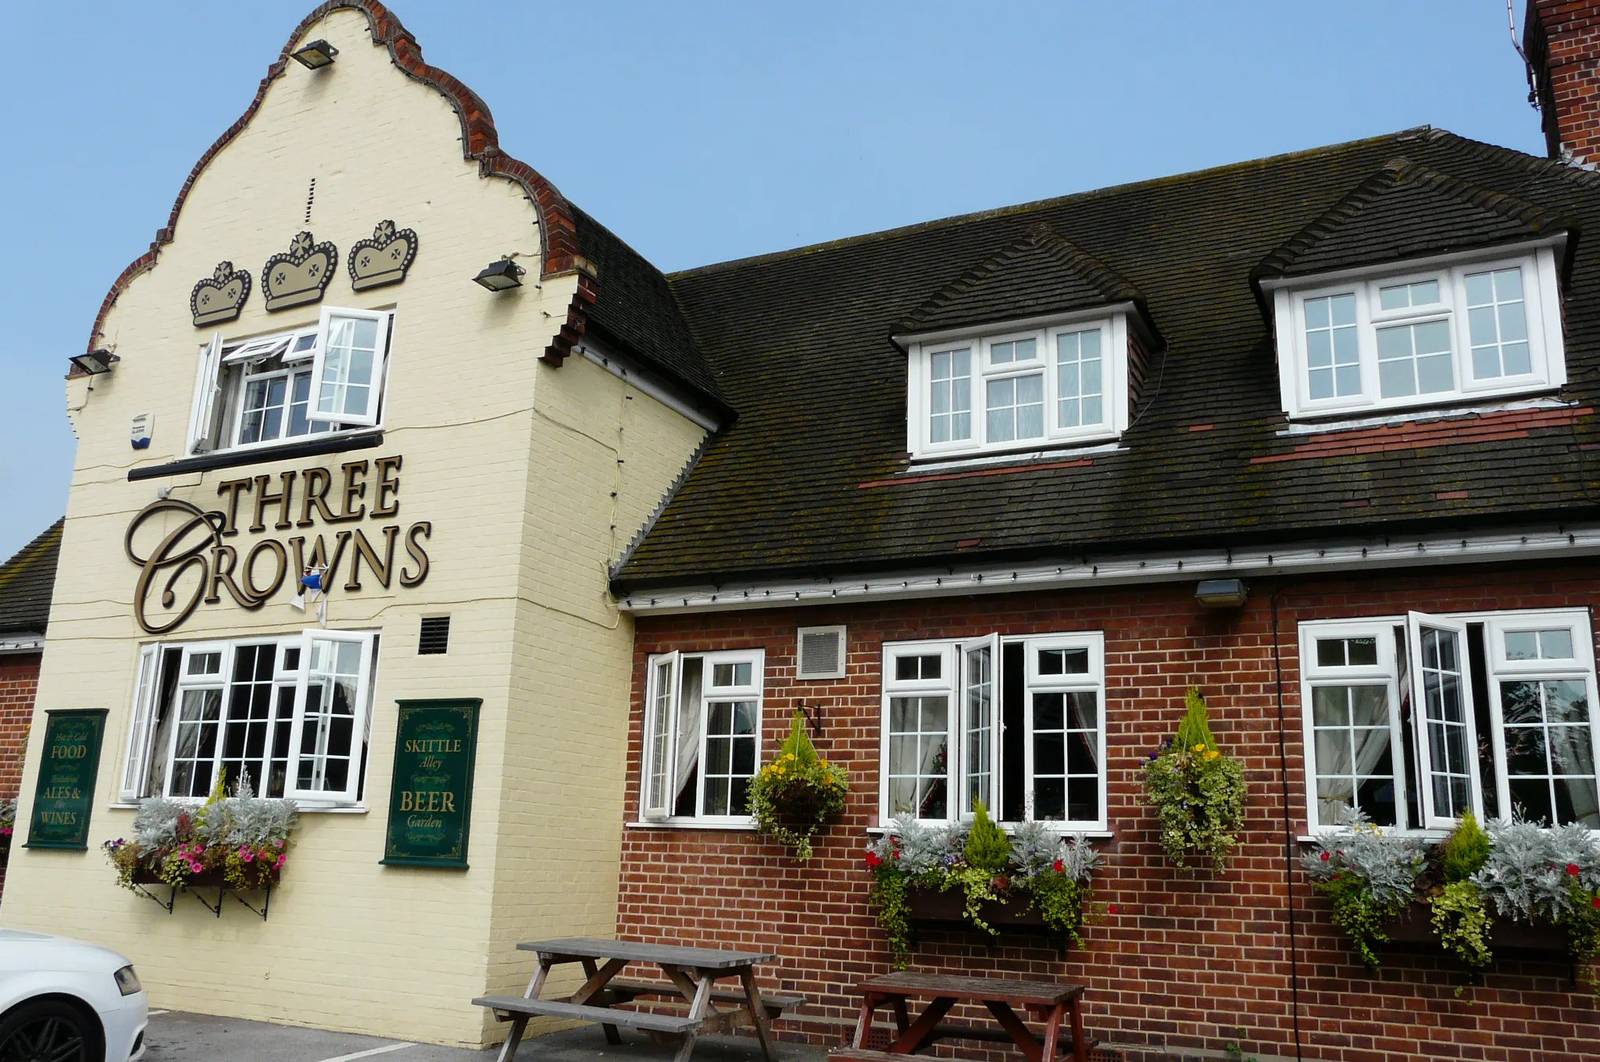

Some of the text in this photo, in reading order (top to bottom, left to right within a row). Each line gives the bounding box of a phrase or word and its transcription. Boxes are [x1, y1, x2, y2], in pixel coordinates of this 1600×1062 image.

[217, 454, 402, 537] THREE
[124, 498, 433, 635] CROWNS
[50, 745, 87, 759] FOOD
[404, 739, 461, 753] SKITTLE
[418, 755, 442, 770] Alley
[42, 786, 81, 799] ALES &
[399, 791, 456, 813] BEER
[40, 811, 77, 825] WINES
[407, 814, 442, 829] Garden
